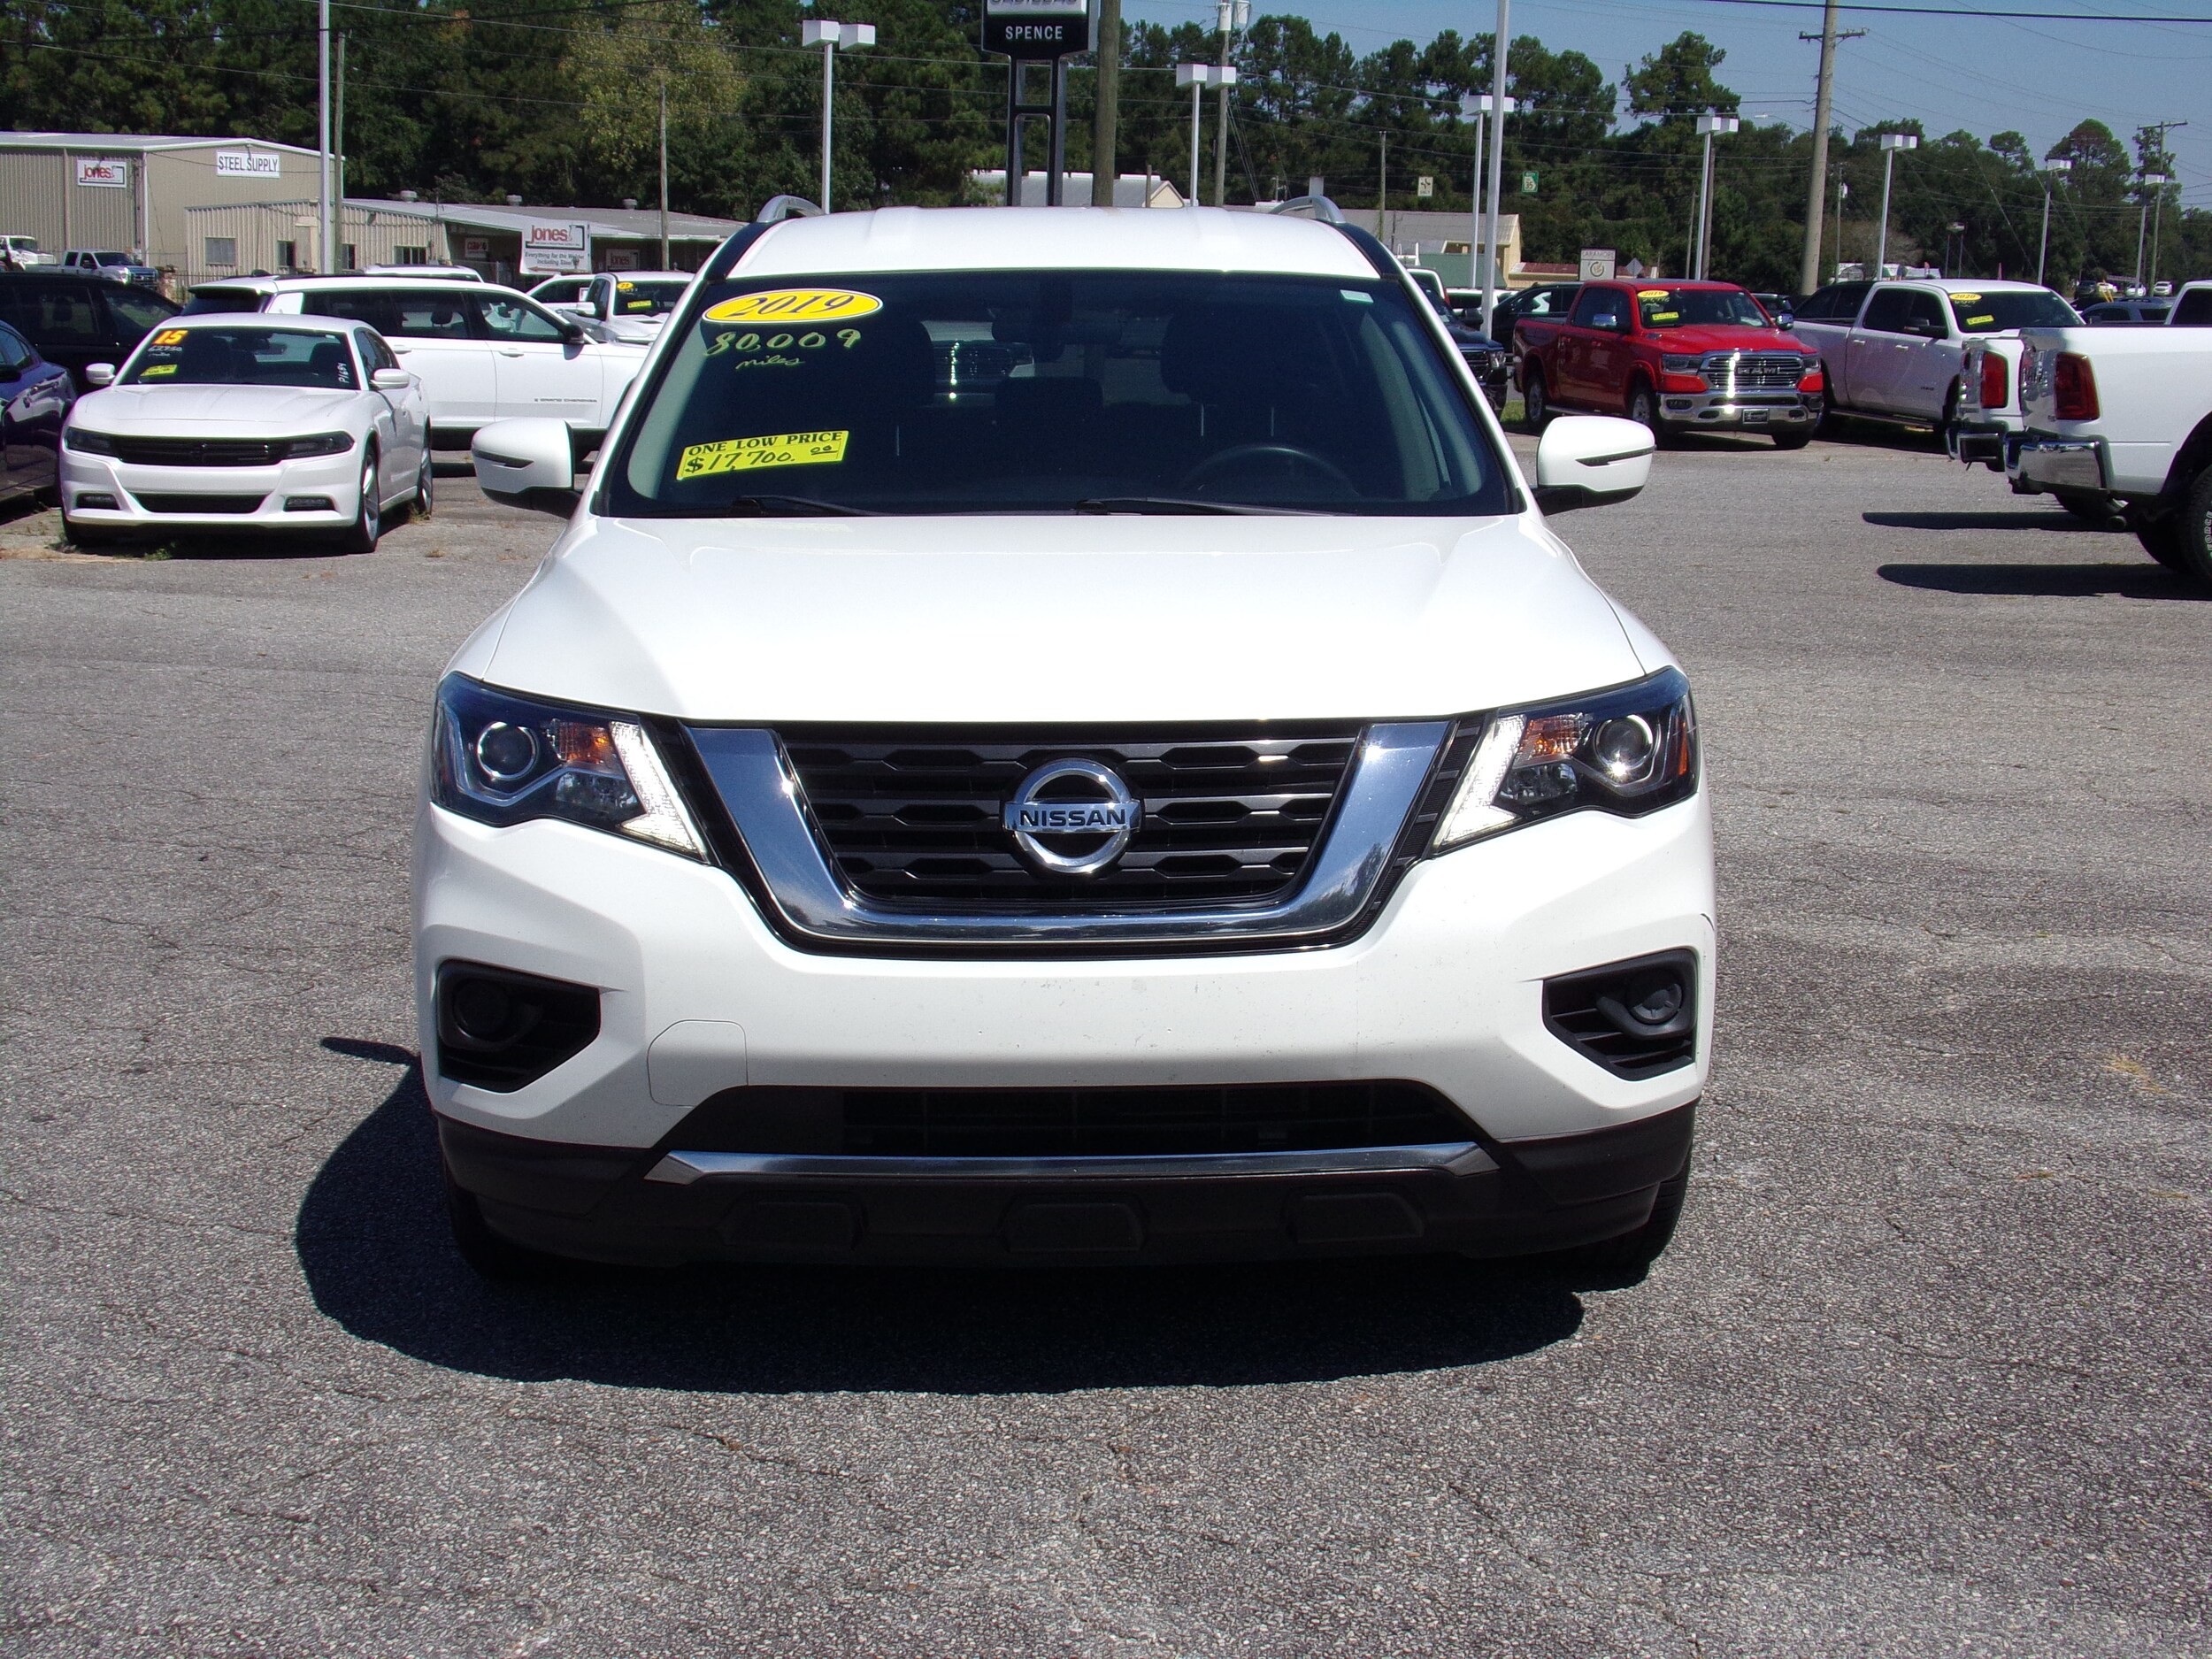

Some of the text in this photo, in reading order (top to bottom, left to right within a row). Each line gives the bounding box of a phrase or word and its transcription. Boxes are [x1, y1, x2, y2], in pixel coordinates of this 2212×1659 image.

[1005, 26, 1063, 40] SPENCE
[218, 157, 279, 173] STEEL SUPPLY
[724, 295, 855, 318] 2019
[151, 329, 188, 345] 15
[735, 355, 806, 370] miles
[687, 432, 843, 457] ONE LOW PRICE
[1019, 809, 1126, 826] NISSAN
